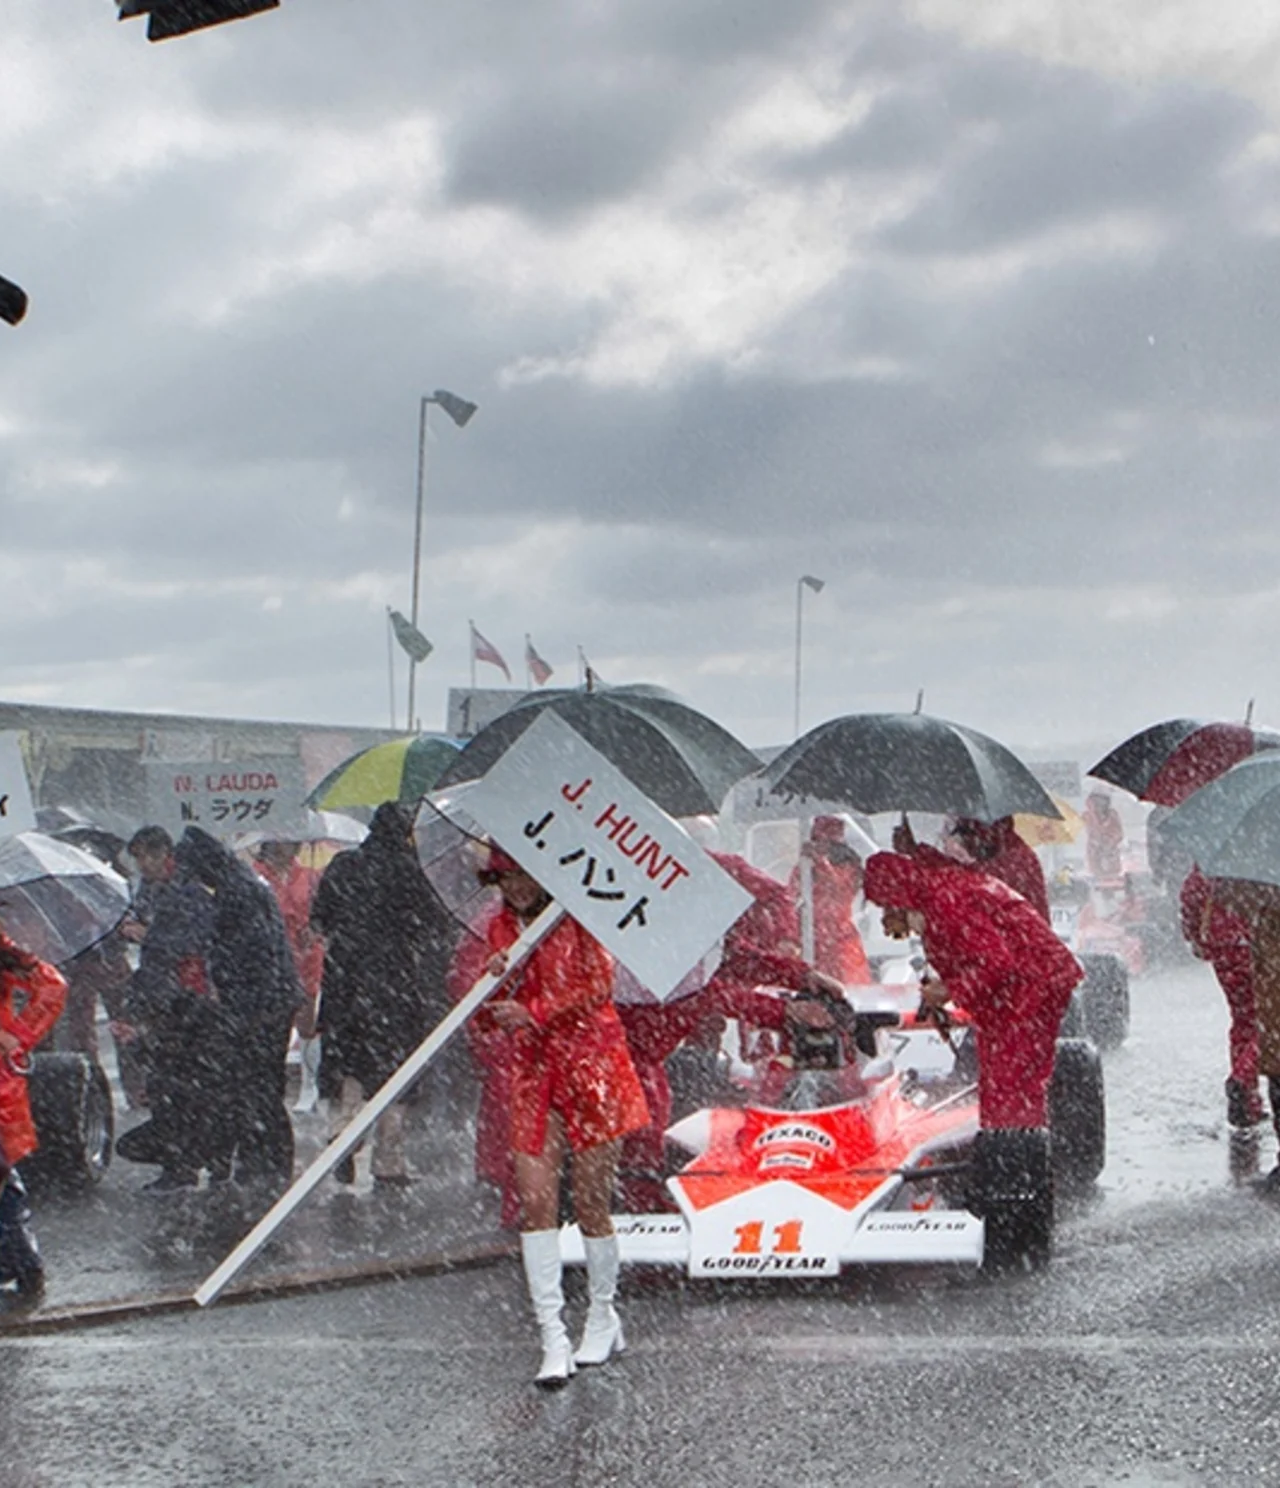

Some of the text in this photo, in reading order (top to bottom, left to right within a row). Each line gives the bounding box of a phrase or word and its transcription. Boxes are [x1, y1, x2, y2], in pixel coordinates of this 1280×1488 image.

[173, 771, 279, 794] N. LAUDA
[212, 797, 275, 822] ラウダ
[560, 778, 691, 891] J. HUNT
[523, 810, 650, 931] J. ハント
[756, 1126, 832, 1149] TEXACO
[732, 1219, 805, 1255] 11
[701, 1255, 828, 1274] GOODYEAR
